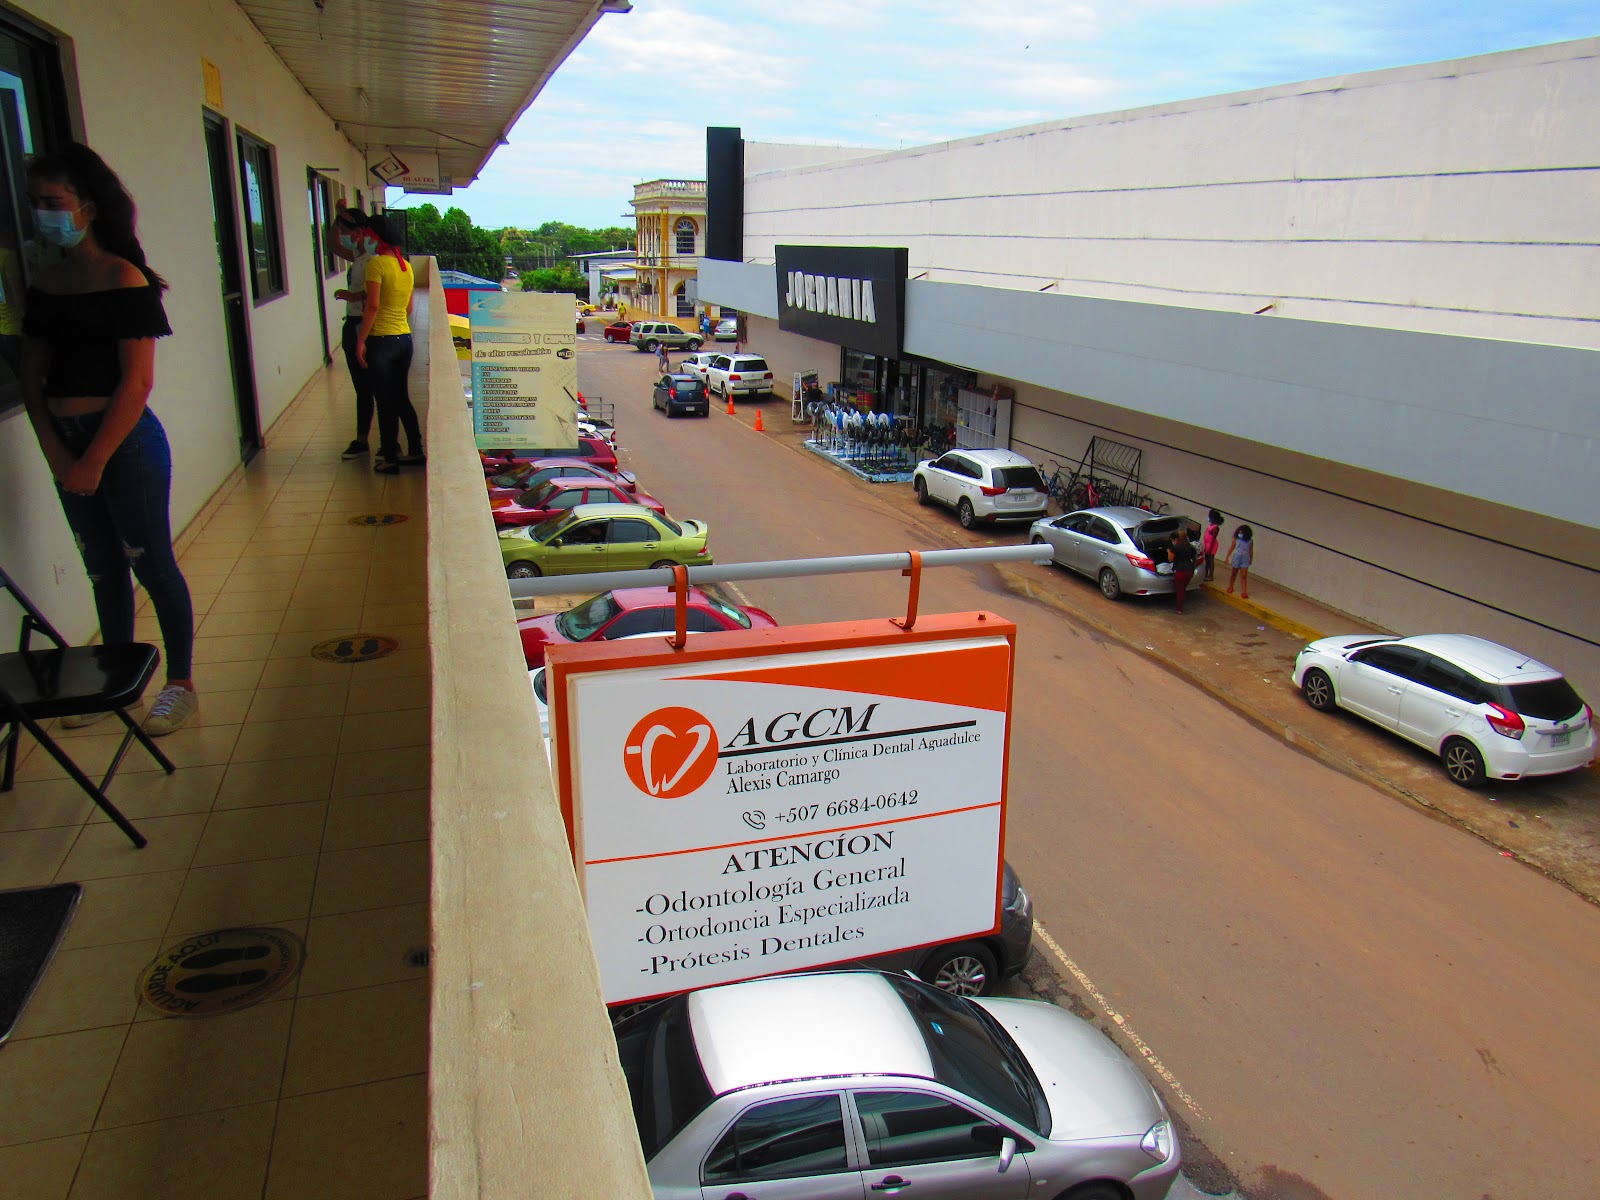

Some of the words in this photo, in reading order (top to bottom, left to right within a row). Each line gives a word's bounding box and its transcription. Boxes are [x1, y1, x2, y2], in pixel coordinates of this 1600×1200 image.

[786, 271, 876, 323] JORDANIA
[475, 350, 486, 358] de
[488, 350, 505, 358] alta
[724, 702, 881, 749] AGCM
[727, 753, 808, 775] Laboratorio
[812, 754, 820, 768] y
[823, 746, 868, 763] Clínica
[873, 739, 914, 756] Dental
[918, 732, 981, 752] Aguadulce
[726, 770, 772, 795] Alexis
[776, 767, 840, 788] Camargo
[775, 804, 819, 825] +507
[826, 790, 918, 817] 6684-0642
[813, 858, 906, 892] General
[778, 887, 910, 926] Especializada
[761, 925, 865, 957] Dentales
